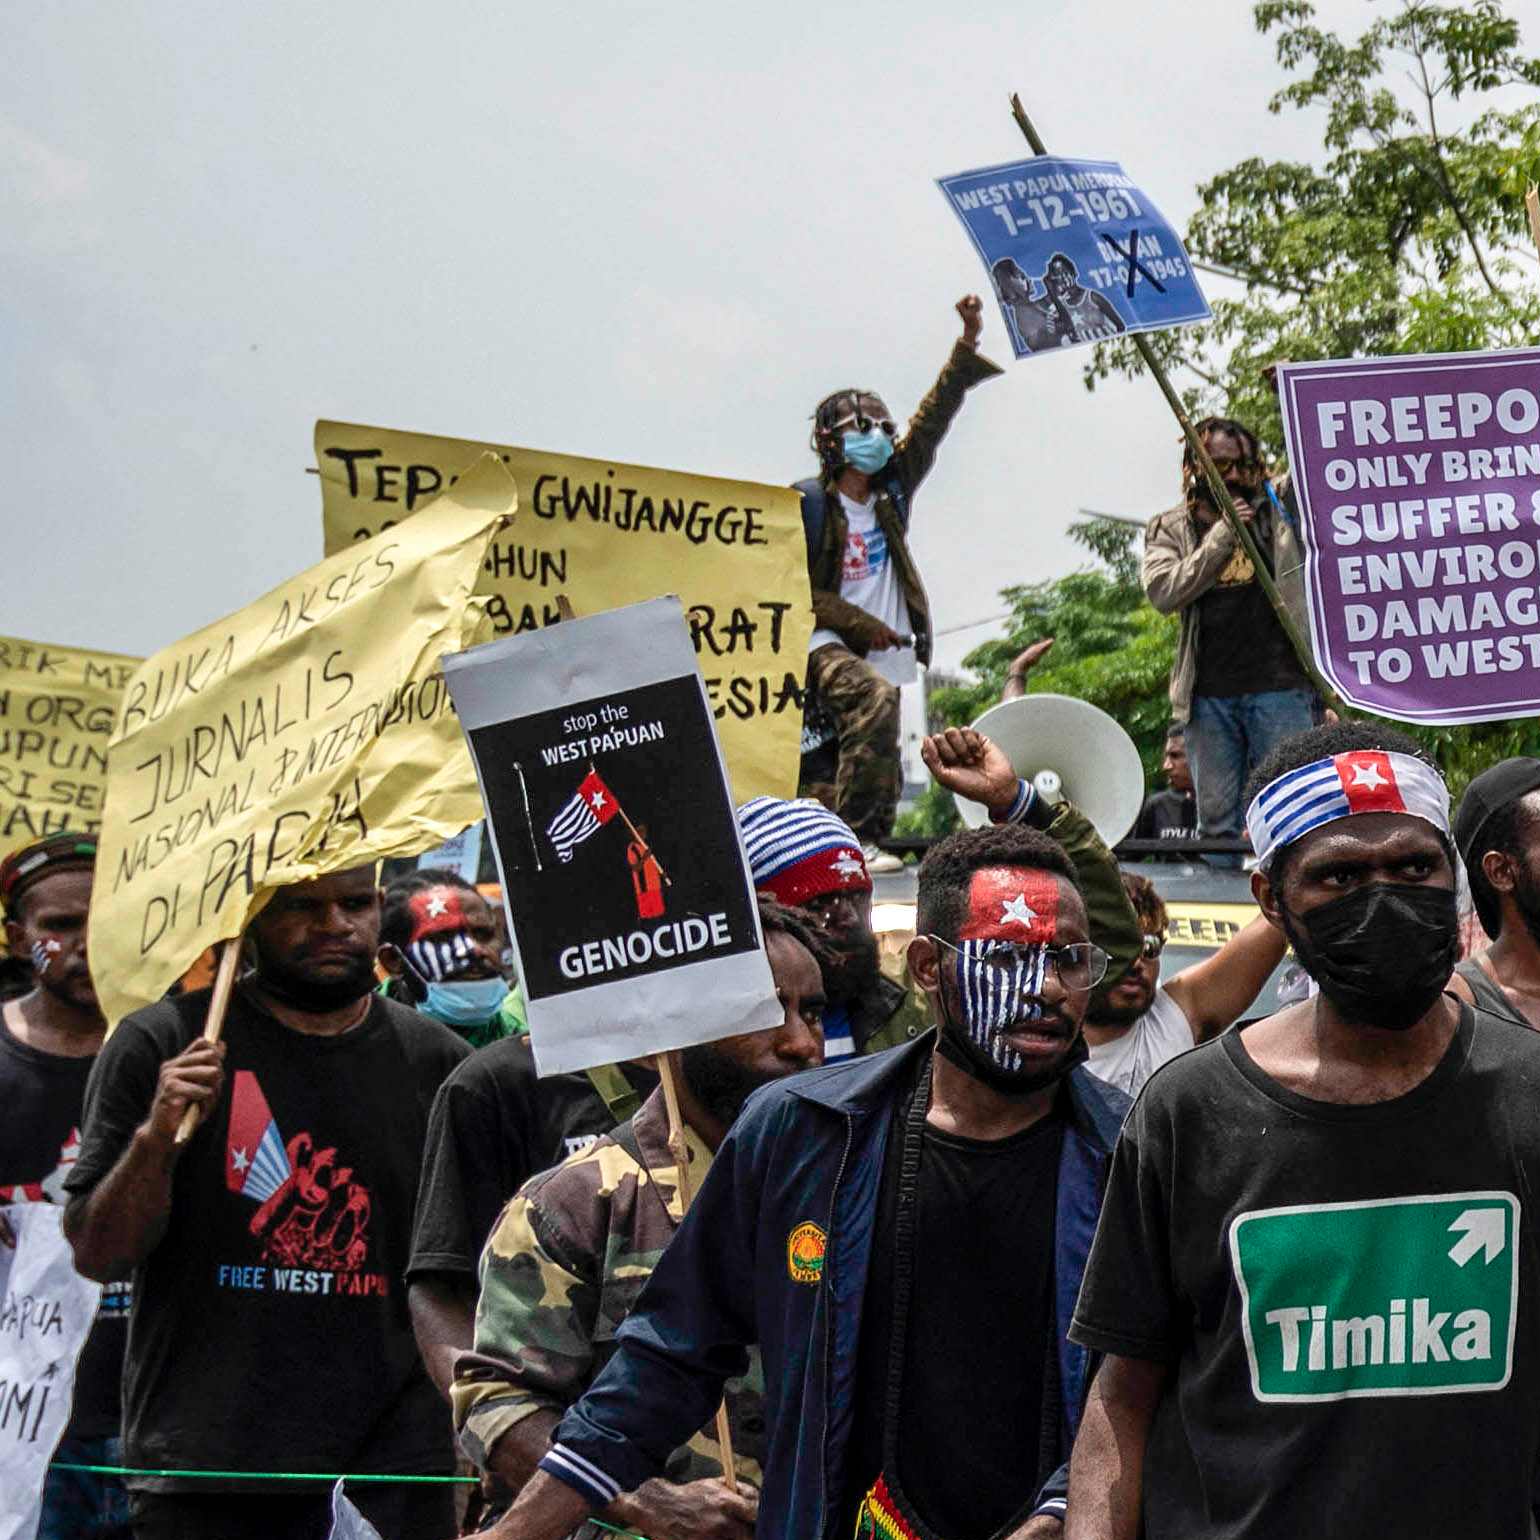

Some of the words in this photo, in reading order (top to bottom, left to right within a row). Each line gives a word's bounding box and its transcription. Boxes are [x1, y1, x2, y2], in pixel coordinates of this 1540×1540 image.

[955, 185, 1014, 211] WEST
[1013, 173, 1074, 200] PAPUA
[1325, 452, 1432, 491] ONLY
[1331, 492, 1520, 546] SUFFER
[484, 543, 566, 587] HUN
[1347, 646, 1413, 686] TO
[130, 650, 354, 824] JURNALIS
[563, 711, 599, 736] stop
[600, 704, 630, 724] the
[542, 737, 589, 767] WEST
[559, 911, 733, 980] GENOCIDE
[218, 1264, 267, 1289] FREE
[272, 1268, 335, 1295] WEST
[1265, 1295, 1494, 1373] Timika
